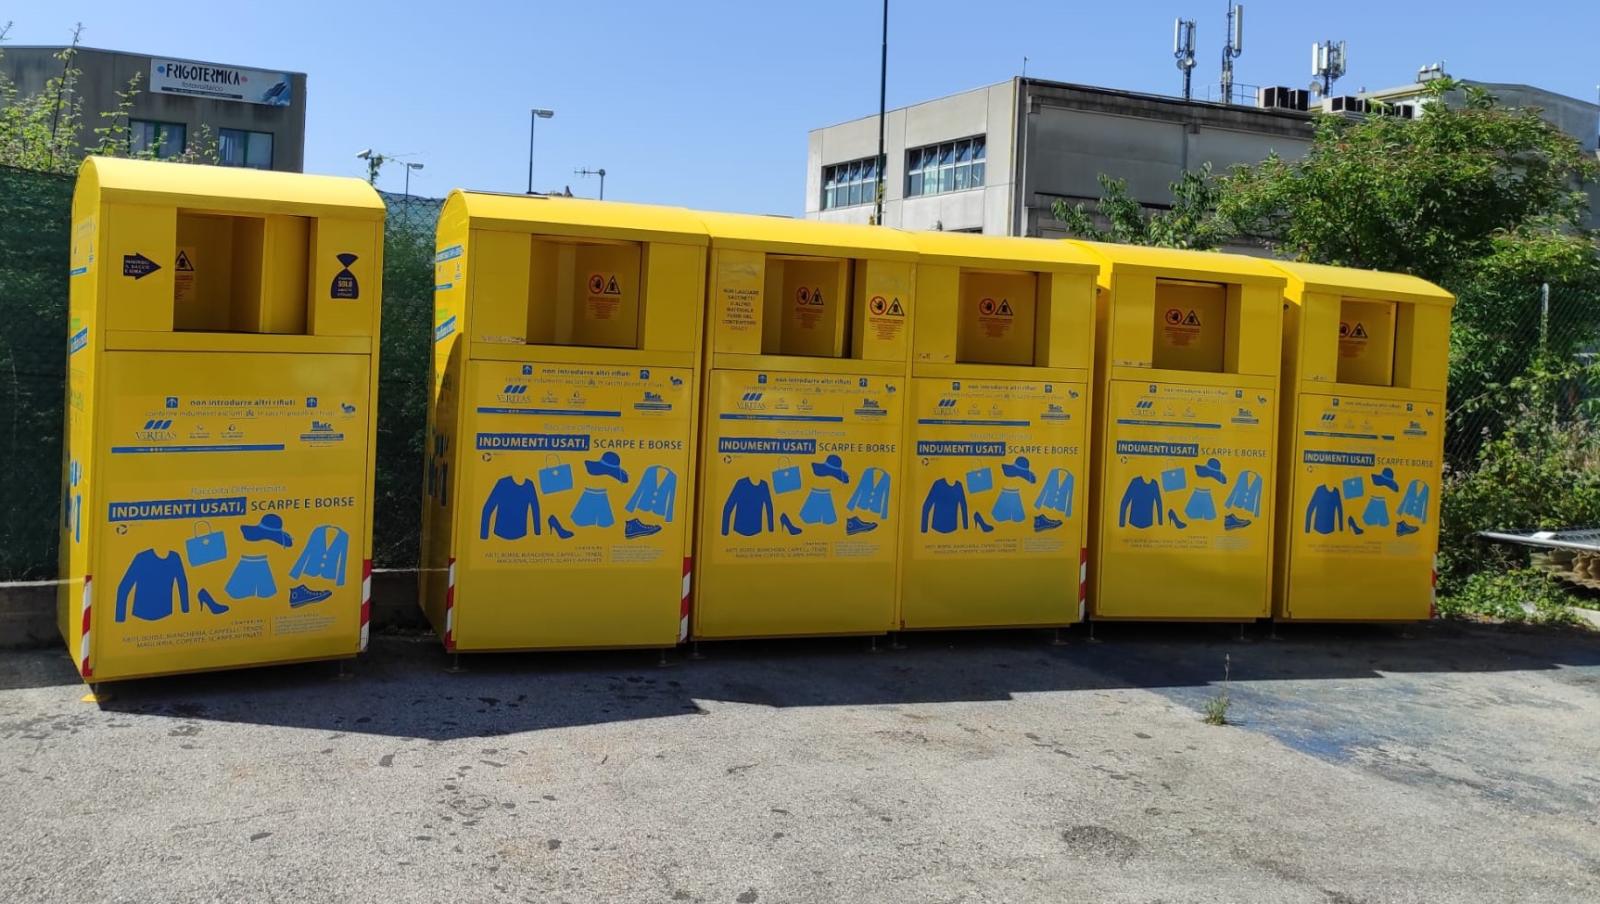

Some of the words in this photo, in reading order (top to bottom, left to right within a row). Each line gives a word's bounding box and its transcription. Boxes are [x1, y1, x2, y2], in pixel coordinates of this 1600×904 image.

[166, 63, 240, 85] FRIGOTERMICA
[209, 399, 251, 407] introdurre
[136, 432, 177, 441] VERITAS
[479, 436, 548, 448] INDUMENTI
[551, 438, 588, 450] USATI,
[593, 439, 636, 449] SCARPE
[639, 440, 645, 449] E
[649, 440, 683, 450] BORSE
[720, 441, 781, 451] INDUMENTI
[783, 442, 815, 452] USATI,
[819, 442, 854, 452] SCARPE
[857, 443, 863, 452] E
[866, 444, 896, 453] BORSE
[919, 444, 974, 453] INDUMENTI
[976, 445, 1005, 455] USATI,
[1008, 446, 1041, 454] SCARPE
[1044, 446, 1048, 454] E
[1052, 447, 1078, 455] BORSE
[1118, 443, 1169, 453] INDUMENTI
[1170, 445, 1198, 455] USATI,
[1201, 448, 1232, 456] SCARPE
[1234, 448, 1239, 457] E
[1241, 448, 1267, 457] BORSE
[1304, 451, 1350, 464] INDUMENTI
[1351, 454, 1374, 466] USATI,
[1376, 456, 1403, 465] SCARPE
[112, 504, 197, 518] INDUMENTI
[200, 502, 245, 515] USATI,
[252, 499, 300, 511] SCARPE
[304, 498, 310, 508] E
[315, 497, 354, 508] BORSE
